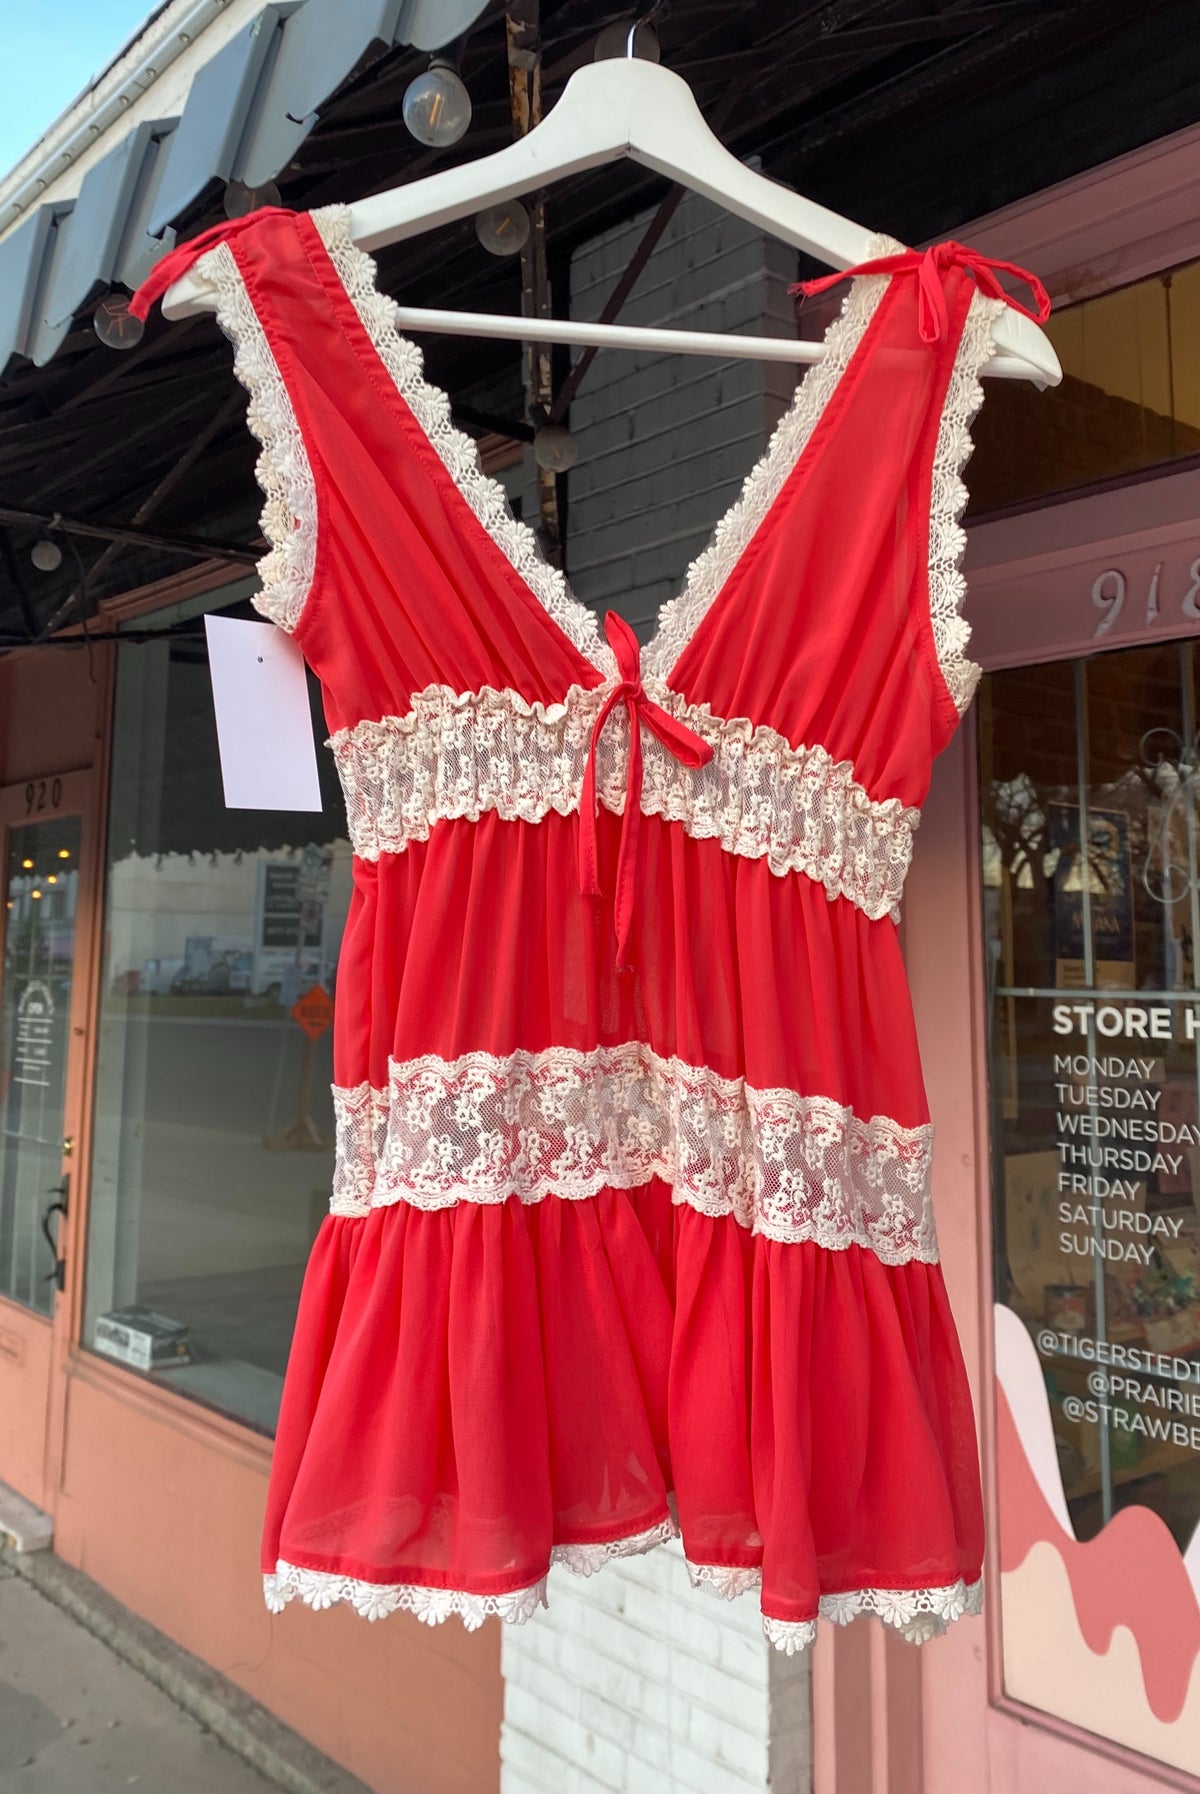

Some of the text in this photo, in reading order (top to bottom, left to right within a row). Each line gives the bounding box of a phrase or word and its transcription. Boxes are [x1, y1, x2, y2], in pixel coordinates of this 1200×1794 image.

[25, 779, 61, 817] 920
[1053, 1005, 1172, 1039] STORE
[1054, 1054, 1156, 1080] MONDAY
[1055, 1083, 1161, 1111] TUESDAY
[1057, 1143, 1183, 1175] THURSDAY
[1059, 1173, 1141, 1201] FRIDAY
[1059, 1203, 1184, 1238] SATURDAY
[1059, 1233, 1155, 1265] SUNDAY
